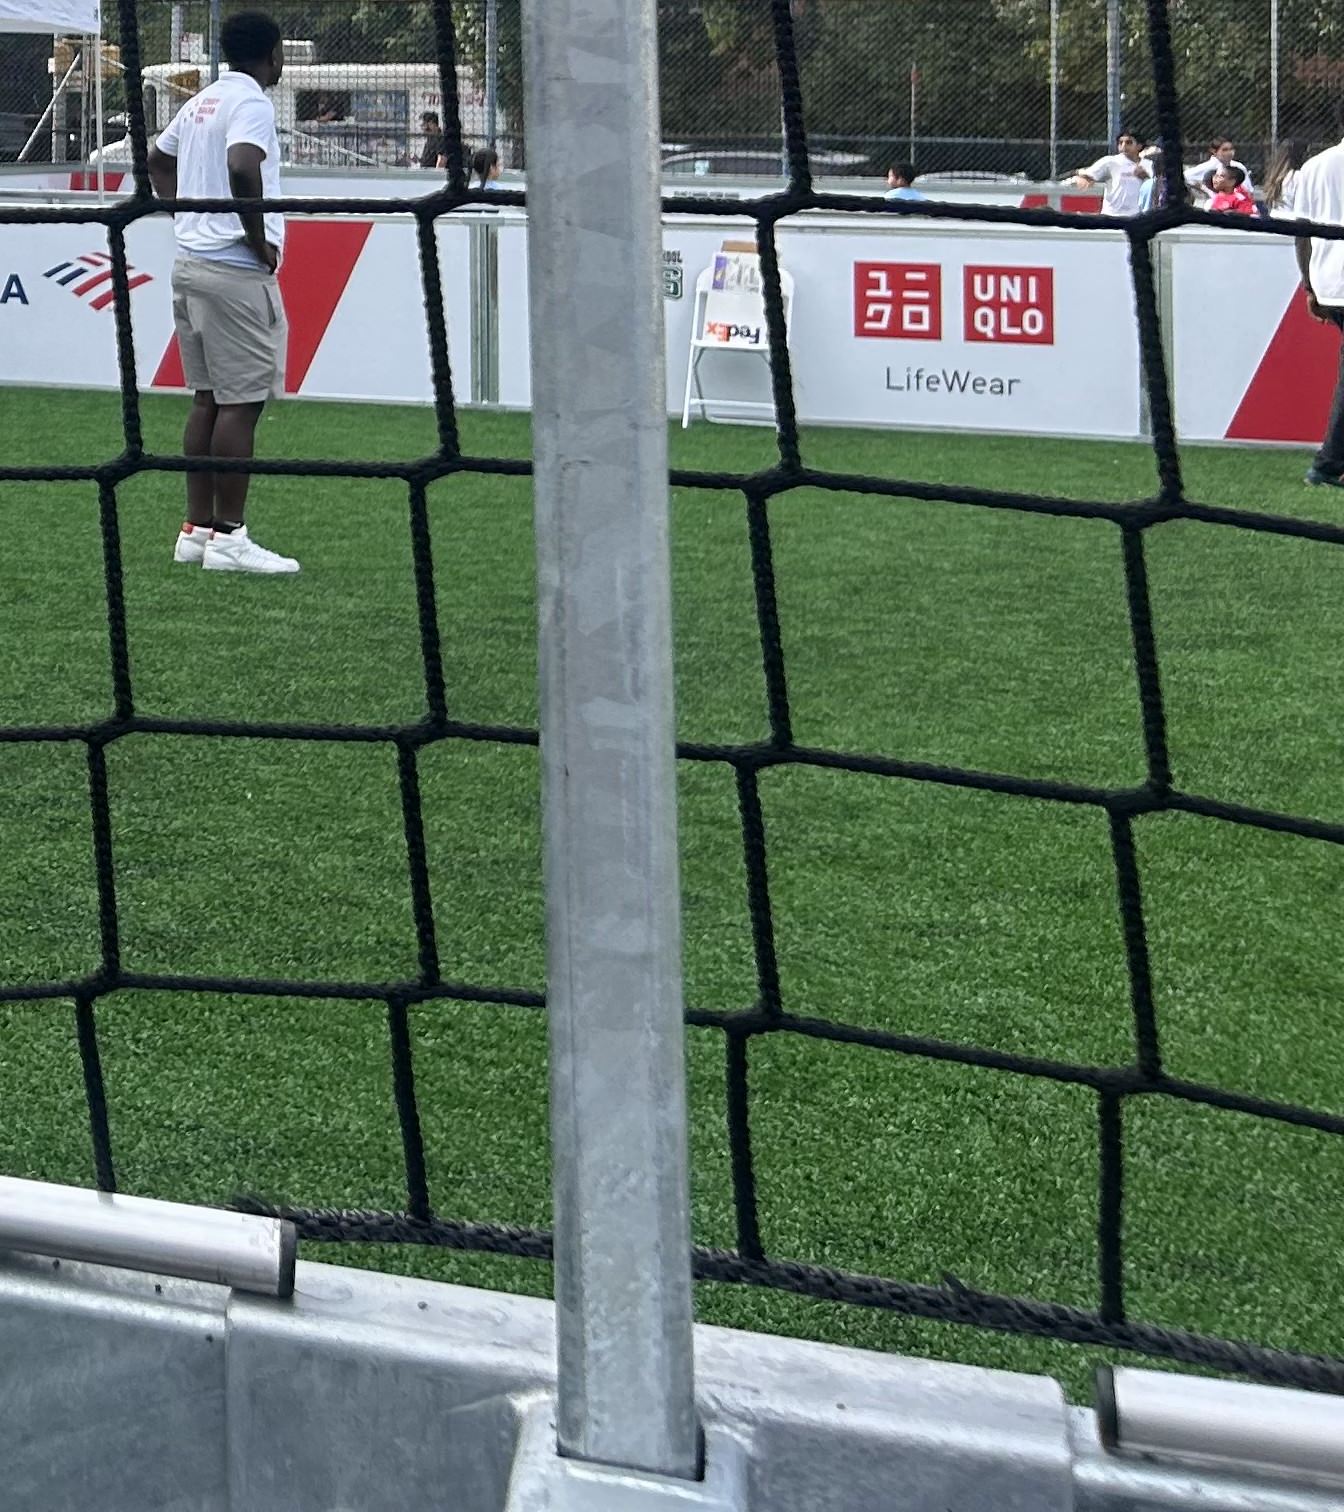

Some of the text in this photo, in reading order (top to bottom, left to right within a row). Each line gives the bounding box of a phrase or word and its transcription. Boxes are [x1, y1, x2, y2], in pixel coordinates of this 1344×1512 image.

[973, 274, 1036, 303] UNI
[706, 322, 760, 344] FedEx
[973, 306, 1044, 339] QLO
[886, 367, 1022, 396] LifeWear
